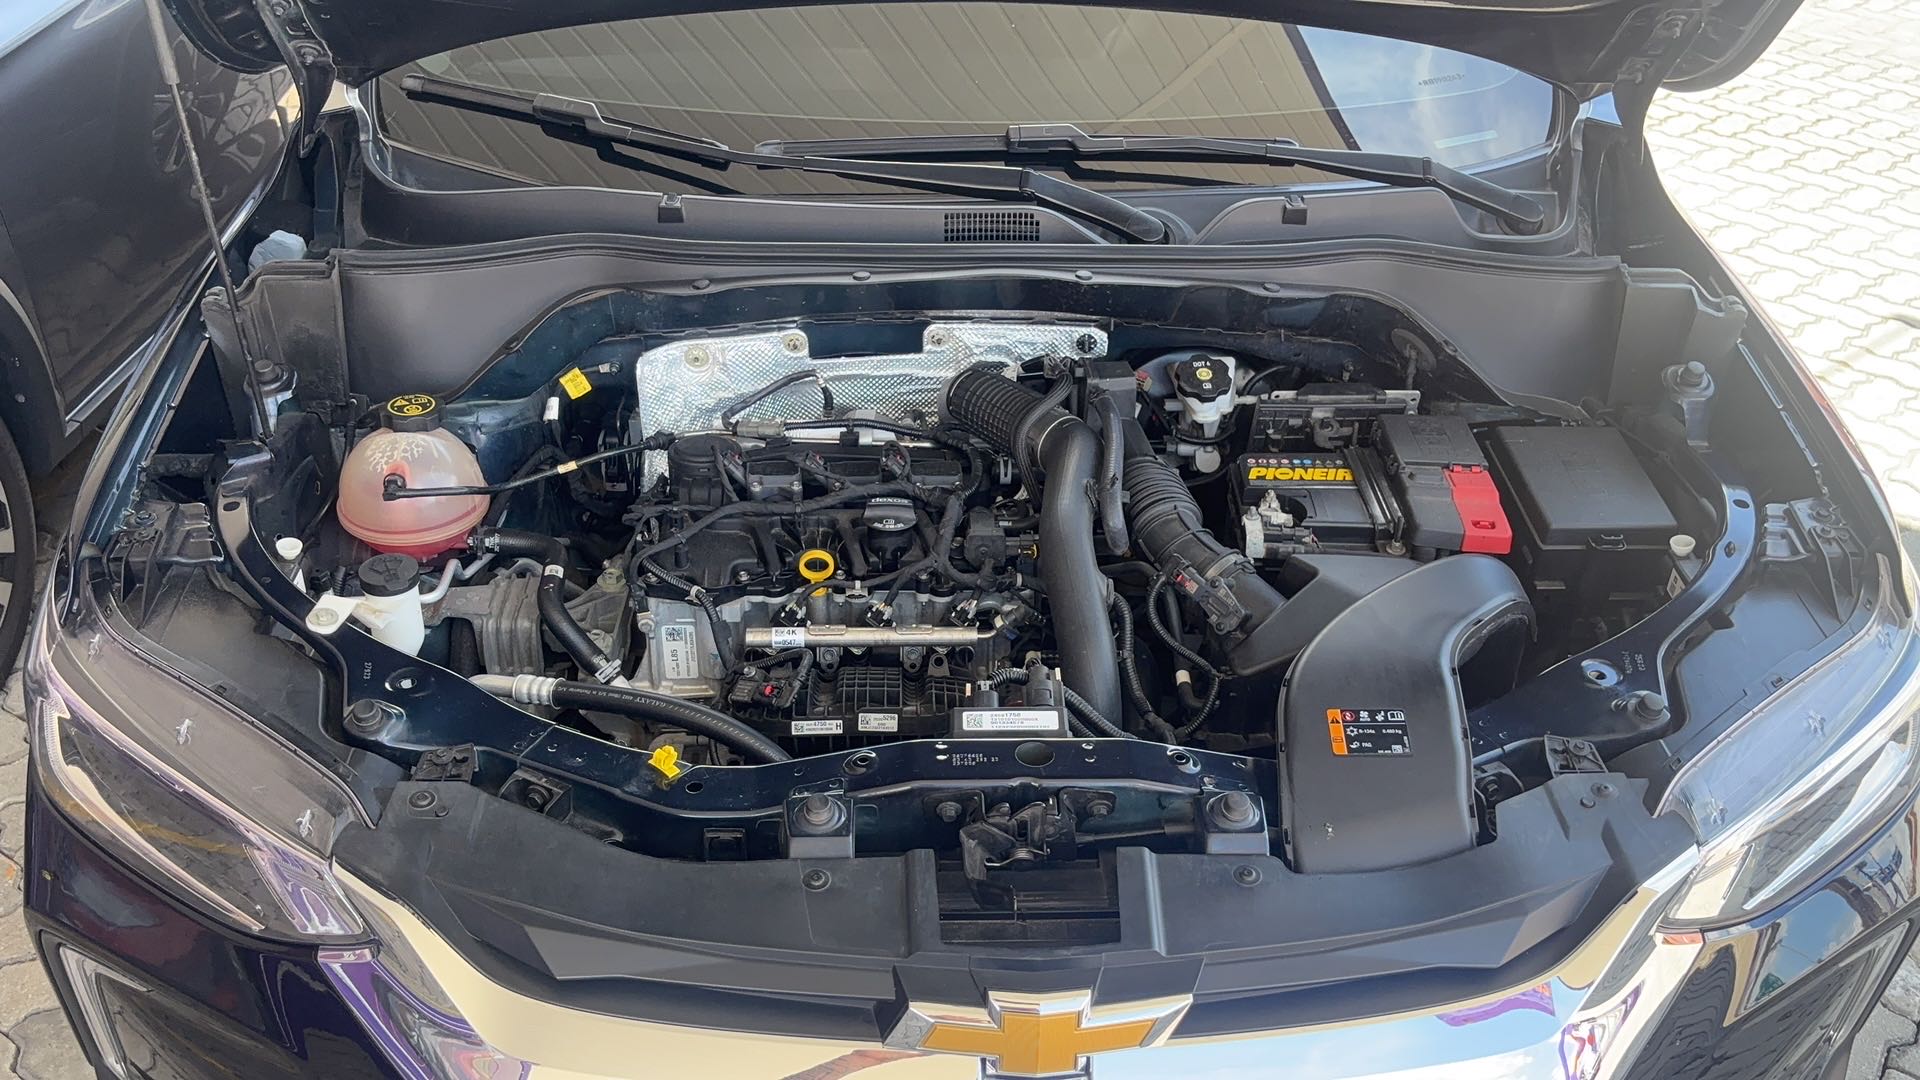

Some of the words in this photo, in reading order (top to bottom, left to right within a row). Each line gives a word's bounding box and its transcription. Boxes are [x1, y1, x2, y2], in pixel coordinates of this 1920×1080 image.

[1248, 467, 1354, 481] PIONEIR
[635, 696, 667, 709] GALAXY
[835, 722, 842, 730] H
